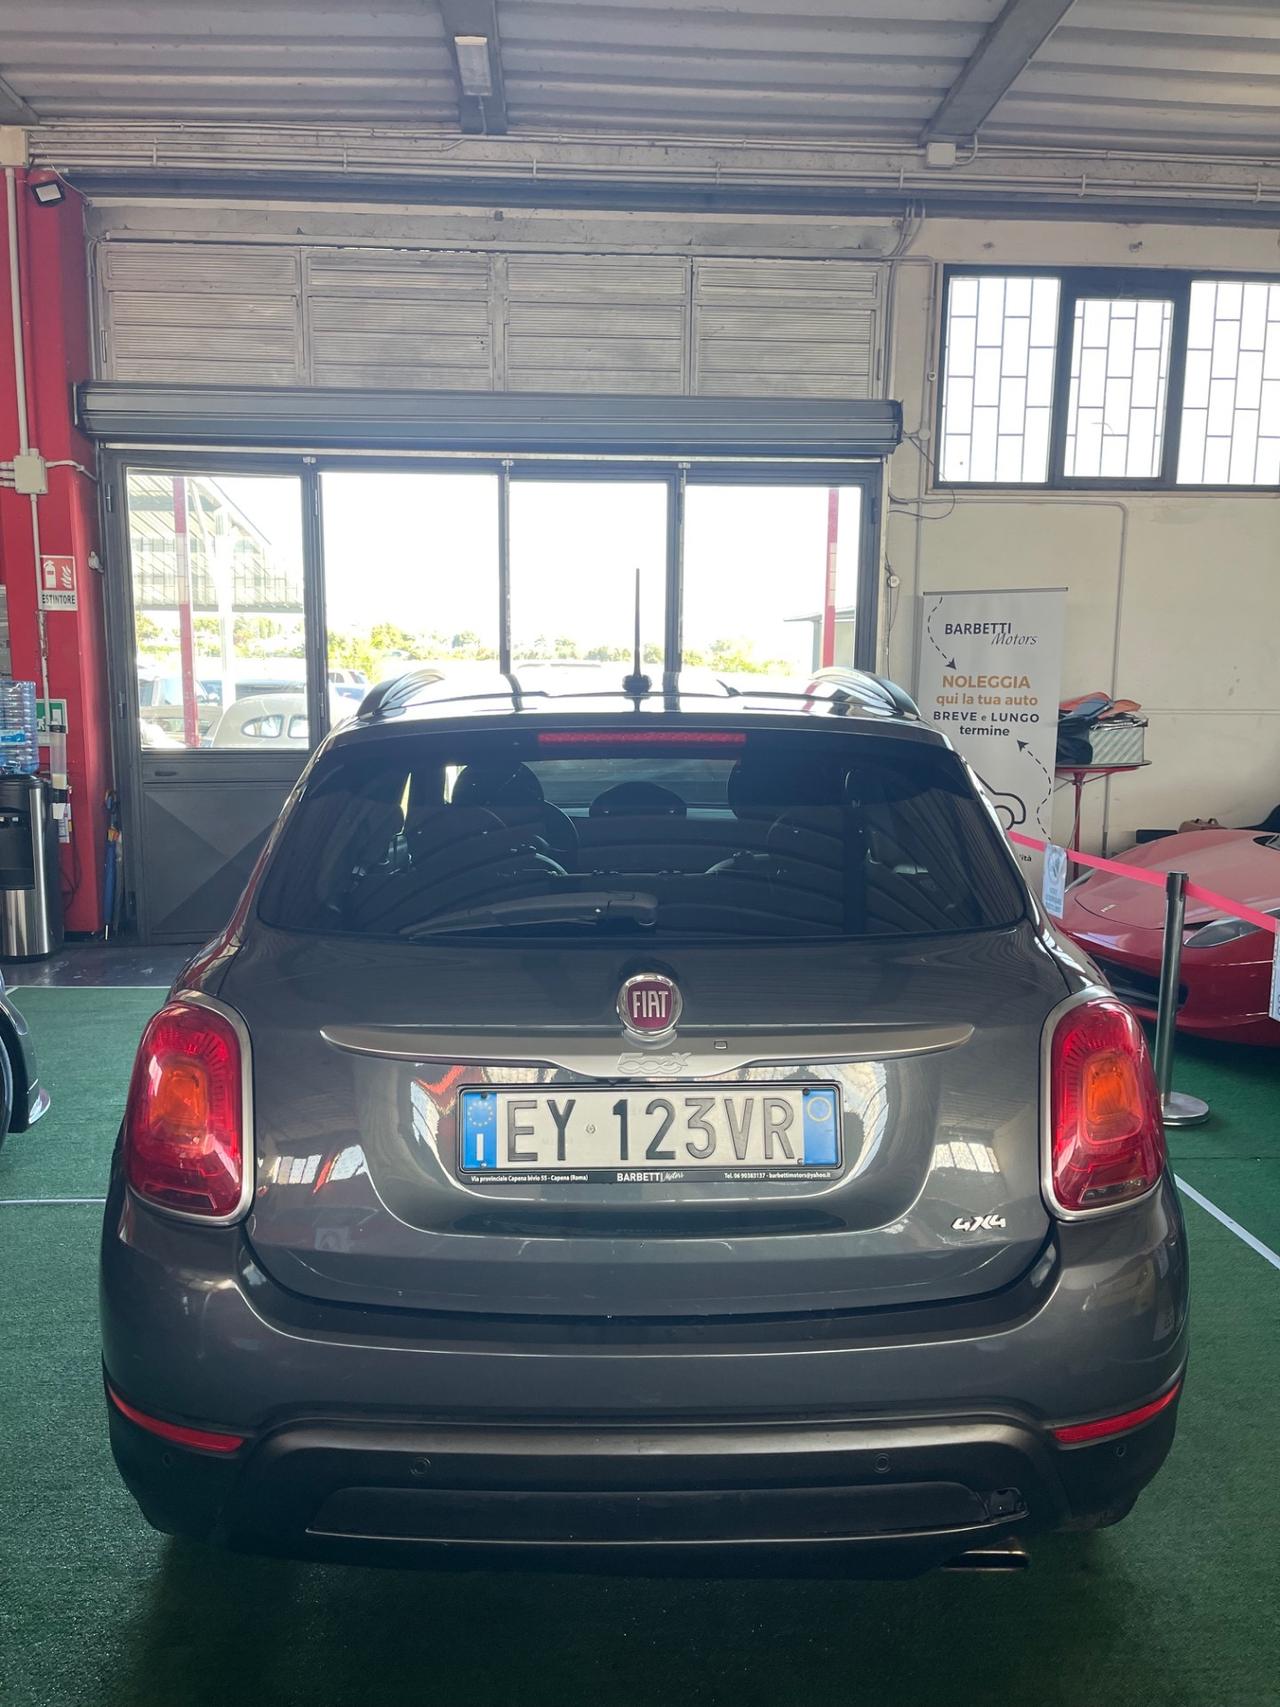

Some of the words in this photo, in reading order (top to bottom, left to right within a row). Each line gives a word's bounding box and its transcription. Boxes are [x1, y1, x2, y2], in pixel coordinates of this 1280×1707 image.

[41, 594, 76, 605] ESTINTORE
[944, 622, 1012, 635] BARBETTI
[990, 632, 1037, 645] Motors
[942, 675, 1031, 689] NOLEGGIA
[936, 692, 960, 706] qui
[961, 692, 975, 705] la
[978, 693, 1002, 705] tua
[1004, 694, 1039, 707] auto
[933, 711, 978, 722] BREVE
[980, 714, 988, 722] e
[991, 712, 1040, 724] LUNGO
[959, 724, 1011, 737] termine
[632, 990, 669, 1019] FIAT
[506, 1098, 577, 1162] EY
[611, 1097, 796, 1161] 123VR
[476, 1133, 484, 1161] I
[616, 1172, 663, 1182] BARBETTI
